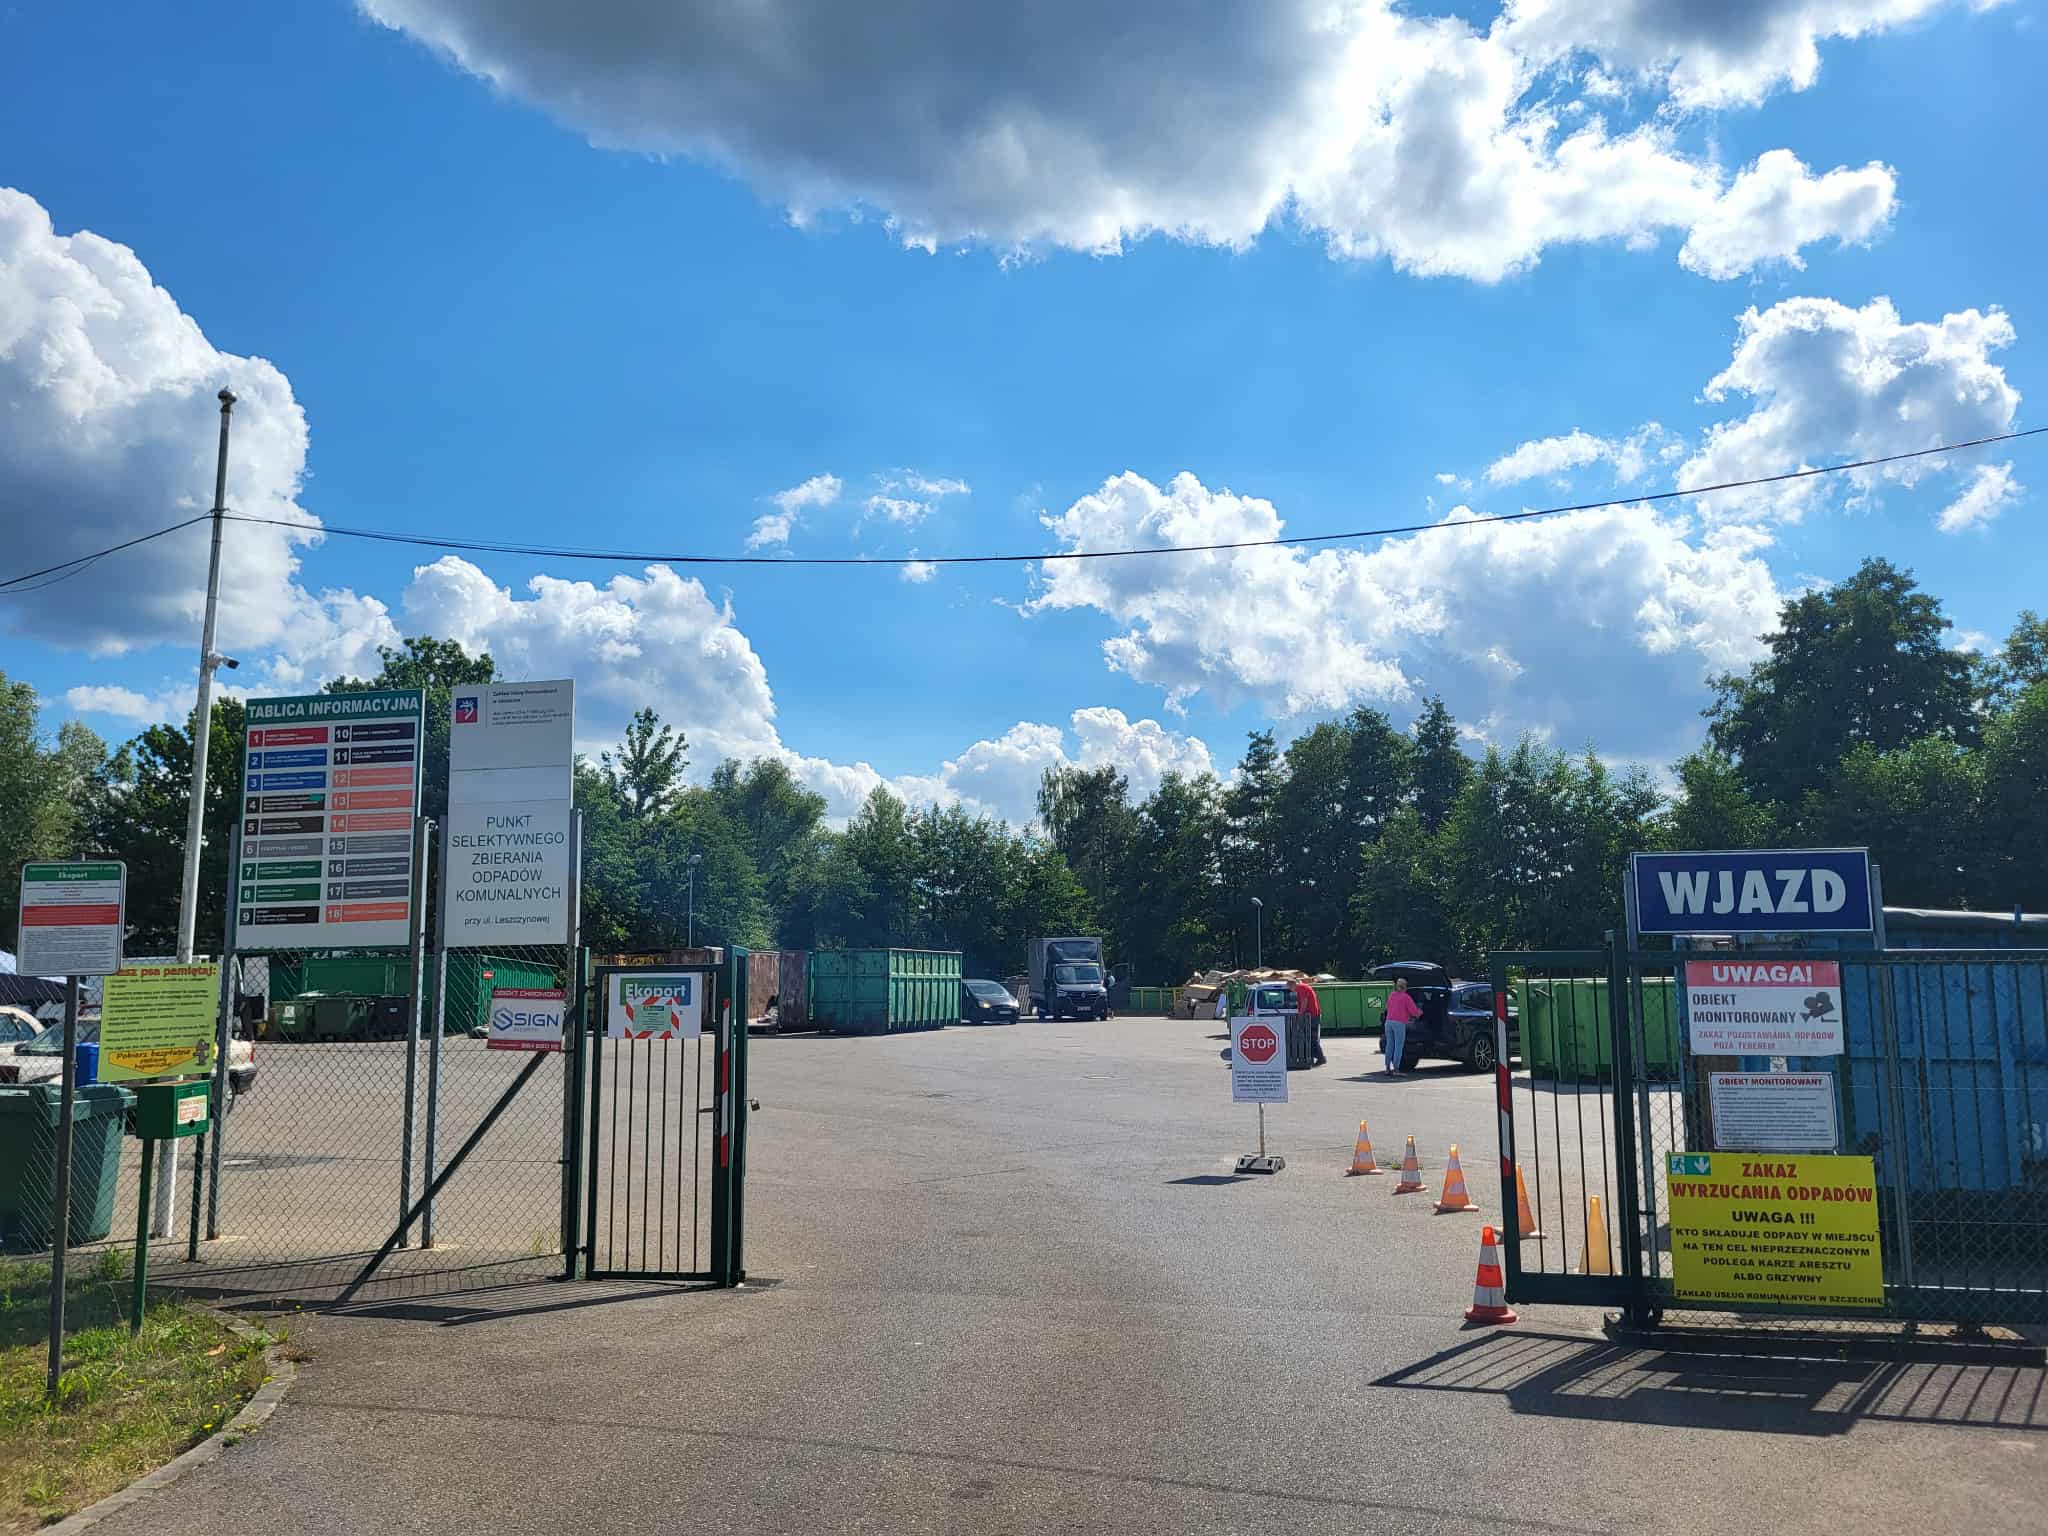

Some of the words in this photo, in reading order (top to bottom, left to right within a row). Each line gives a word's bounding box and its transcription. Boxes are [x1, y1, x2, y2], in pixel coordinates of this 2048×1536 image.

[248, 704, 305, 719] TABLICA
[308, 696, 419, 716] INFORMACYJNA
[253, 732, 261, 744] 1
[335, 728, 349, 740] 10
[250, 756, 260, 766] 2
[334, 752, 348, 762] 11
[250, 777, 259, 788] 3
[334, 773, 348, 784] 12
[249, 801, 257, 811] 4
[334, 796, 347, 807] 13
[247, 821, 256, 832] 5
[332, 818, 346, 829] 14
[487, 815, 531, 829] PUNKT
[331, 840, 345, 851] 15
[451, 832, 565, 848] SELEKTYWNEGO
[246, 844, 254, 855] 6
[471, 851, 544, 866] ZBIERANIA
[245, 867, 252, 877] 7
[330, 864, 344, 873] 16
[472, 867, 543, 884] ODPADÓW
[243, 889, 251, 900] 8
[329, 887, 343, 897] 17
[456, 886, 561, 902] KOMUNALNYCH
[1658, 869, 1847, 915] WJAZD
[242, 911, 250, 923] 9
[327, 909, 340, 920] 18
[464, 916, 480, 927] przy
[1712, 966, 1814, 983] UWAGA!
[625, 983, 687, 998] Ekoport
[1692, 994, 1737, 1006] OBIEKT
[514, 1013, 559, 1027] SIGN
[1694, 1012, 1796, 1024] MONITOROWANY
[1241, 1038, 1275, 1049] STOP
[1718, 1078, 1748, 1086] OBIEKT
[1751, 1078, 1822, 1087] MONITOROWANY
[1742, 1163, 1797, 1178] ZAKAZ
[1671, 1183, 1781, 1200] WYRZUCANIA
[1787, 1184, 1873, 1202] ODPADÓW
[1732, 1211, 1795, 1224] UWAGA
[1800, 1213, 1815, 1225] !!!
[1676, 1229, 1698, 1237] KTO
[1702, 1229, 1760, 1239] SKŁADUJE
[1763, 1231, 1808, 1241] ODPADY
[1812, 1232, 1823, 1241] W
[1825, 1233, 1875, 1243] MIEJSCU
[1683, 1243, 1698, 1251] NA
[1702, 1243, 1724, 1252] TEN
[1727, 1244, 1747, 1252] CEL
[1751, 1245, 1870, 1256] NIEPRZEZNACZONYM
[1703, 1257, 1754, 1267] PODLEGA
[1758, 1259, 1794, 1268] KARZE
[1799, 1260, 1851, 1270] ARESZTU
[1733, 1273, 1763, 1281] ALBO
[1766, 1274, 1822, 1283] GRZYWNY
[1747, 1292, 1816, 1302] KOMUNALNYCH
